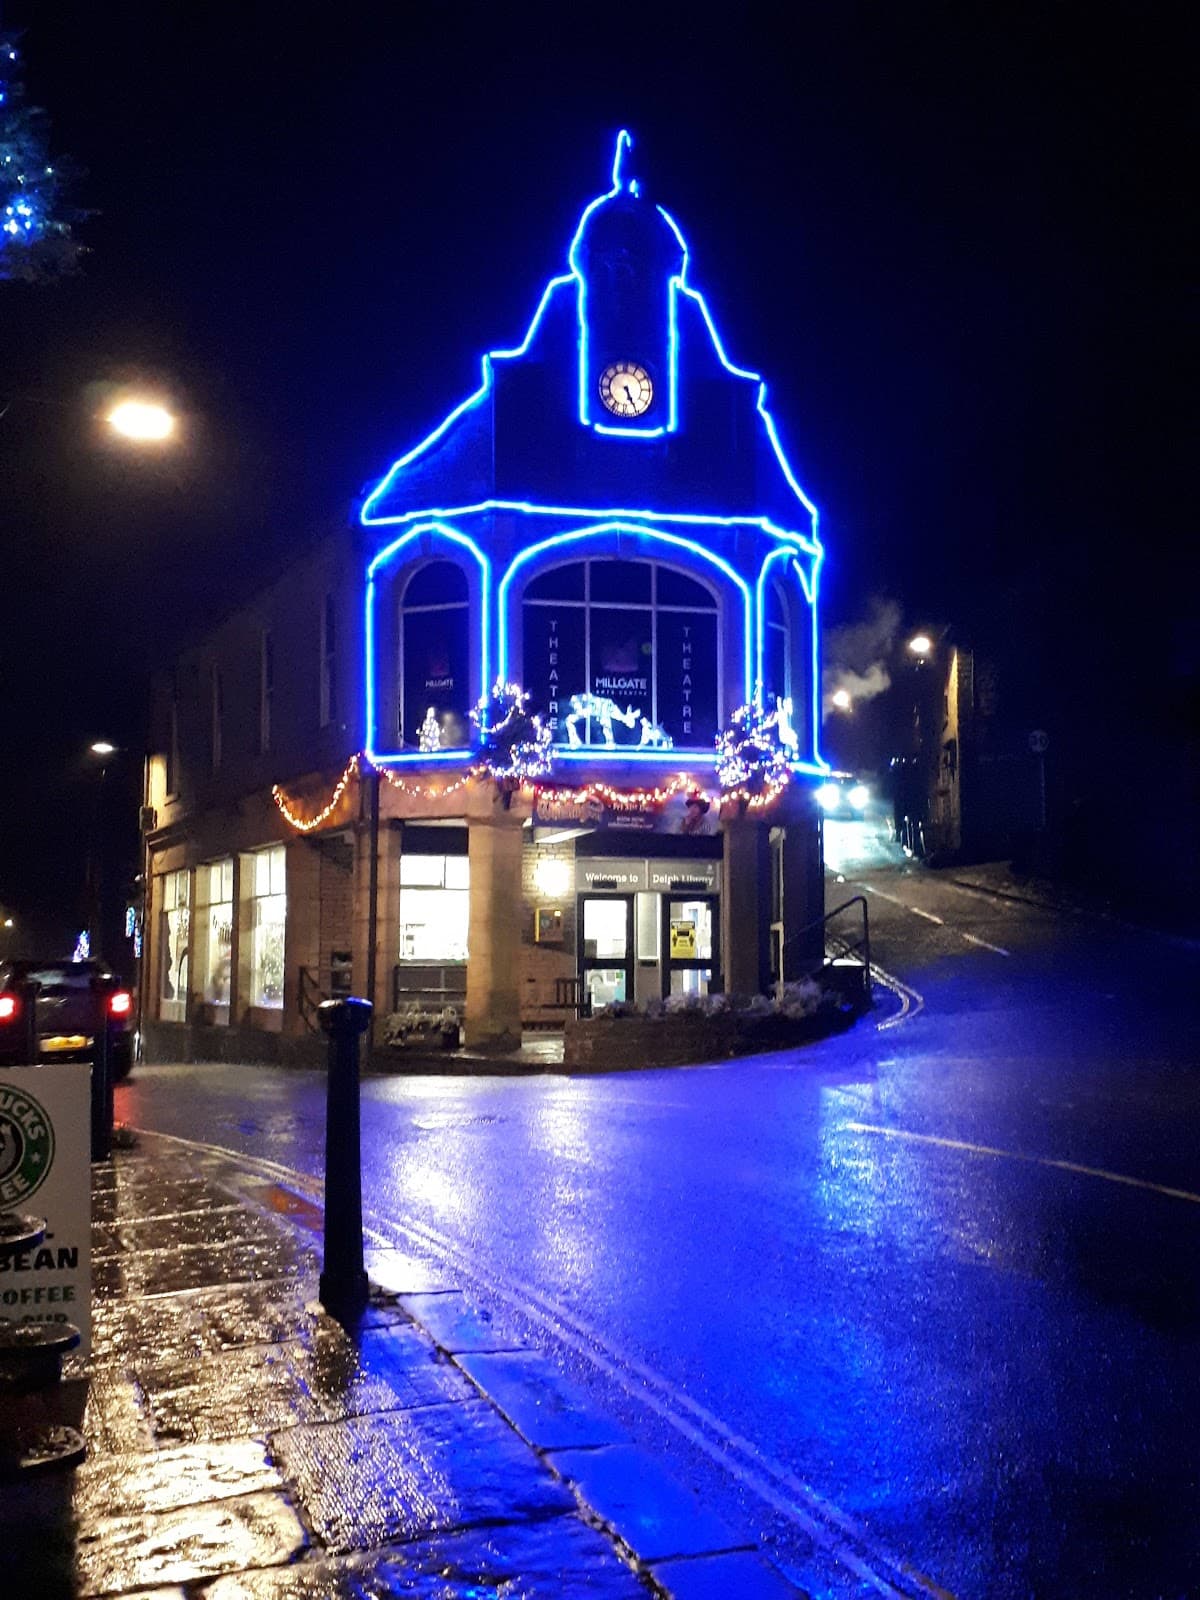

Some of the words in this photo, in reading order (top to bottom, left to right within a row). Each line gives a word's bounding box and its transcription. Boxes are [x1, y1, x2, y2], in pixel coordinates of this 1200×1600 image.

[549, 620, 559, 730] THEATRE
[595, 677, 647, 689] MILLGATE
[682, 626, 692, 734] THEATRE
[585, 872, 628, 883] Welcome
[629, 873, 639, 883] to
[652, 874, 679, 886] Delph
[0, 1285, 77, 1305] OFFEE
